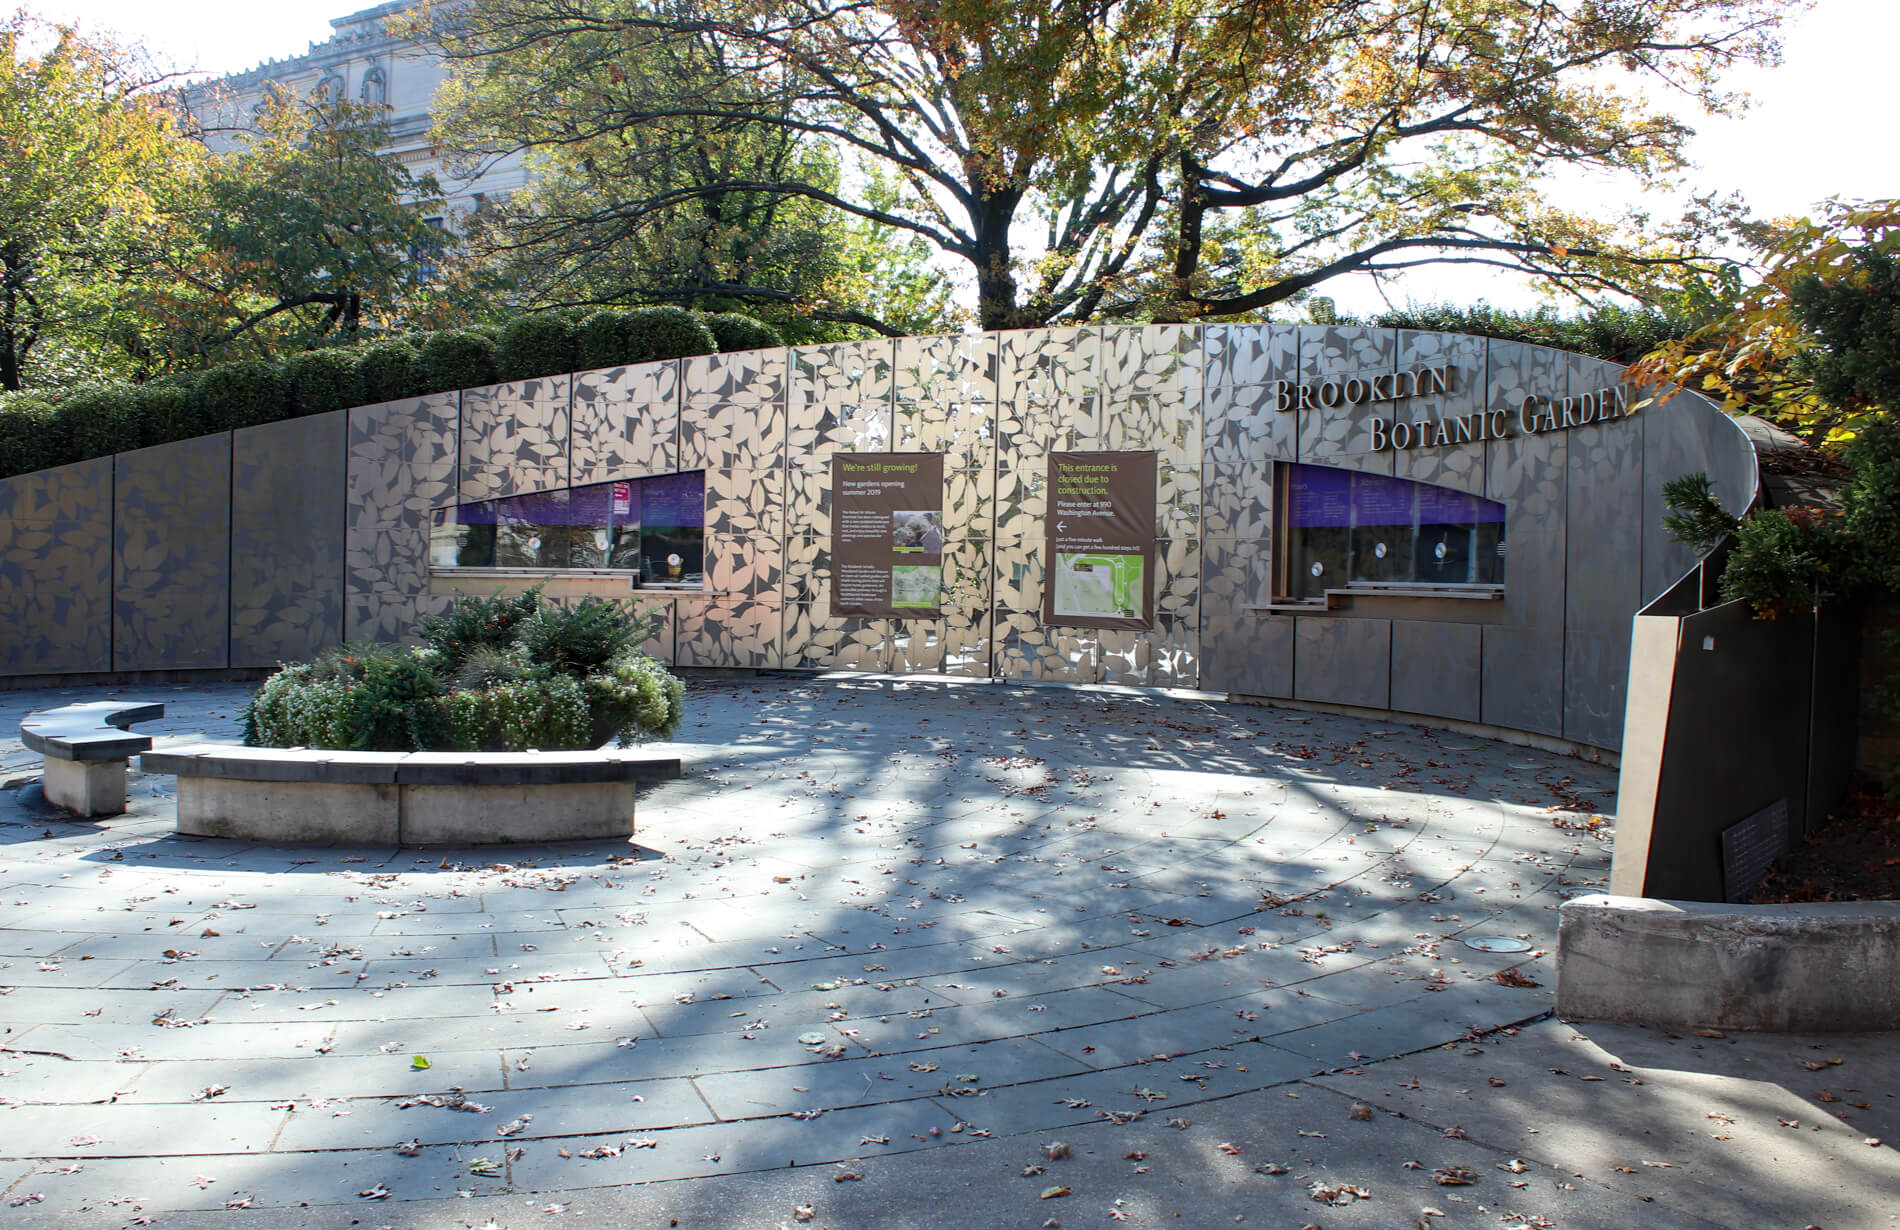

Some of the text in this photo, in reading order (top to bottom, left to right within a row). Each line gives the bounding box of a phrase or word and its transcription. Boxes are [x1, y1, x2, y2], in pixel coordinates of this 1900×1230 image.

[1275, 365, 1449, 412] BROOKLYN
[1370, 383, 1628, 451] BOTANIC GARDEN
[842, 464, 918, 474] We're still growing!
[1058, 464, 1118, 472] This entrance is
[1057, 475, 1110, 483] closed due to
[857, 481, 880, 489] gardens
[881, 481, 905, 489] opening
[1057, 485, 1108, 494] construction.
[1056, 509, 1091, 518] Washington
